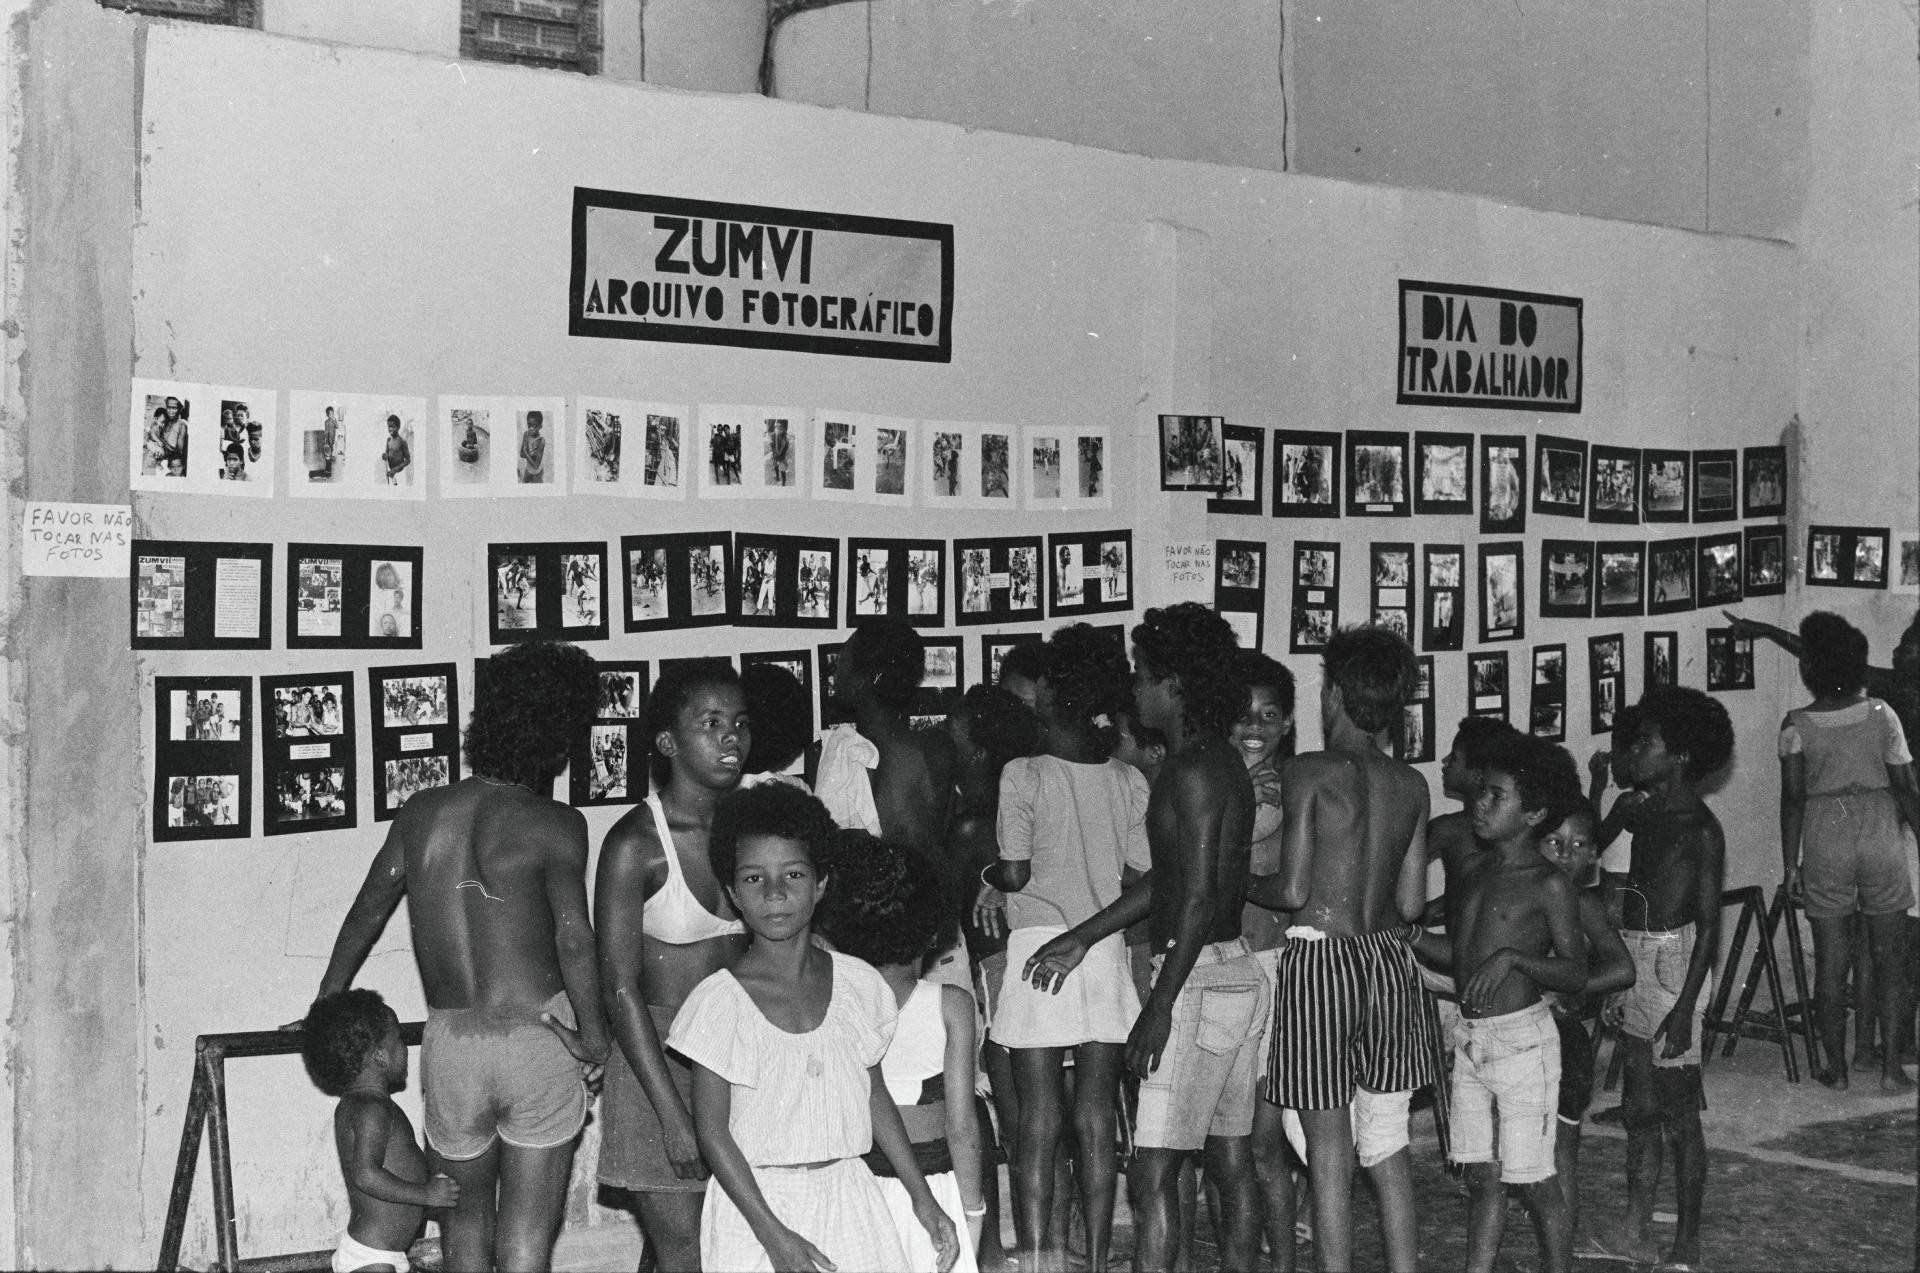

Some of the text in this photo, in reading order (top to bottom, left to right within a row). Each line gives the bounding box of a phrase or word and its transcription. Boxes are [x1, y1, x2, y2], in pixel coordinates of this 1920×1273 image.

[653, 215, 813, 285] ZUMVI
[584, 278, 934, 337] ARQUIVO FOTOGRÁFICO
[1422, 294, 1537, 348] DIA DO
[1406, 346, 1569, 399] TRABALHADOR
[31, 508, 132, 526] FAVOR NÃO
[30, 528, 126, 546] TOCAR NAS
[46, 545, 103, 561] FOTOS
[1165, 544, 1211, 557] FAVOR NÃO
[1166, 559, 1211, 570] TOCAR NAS
[1172, 571, 1204, 583] FOTOS
